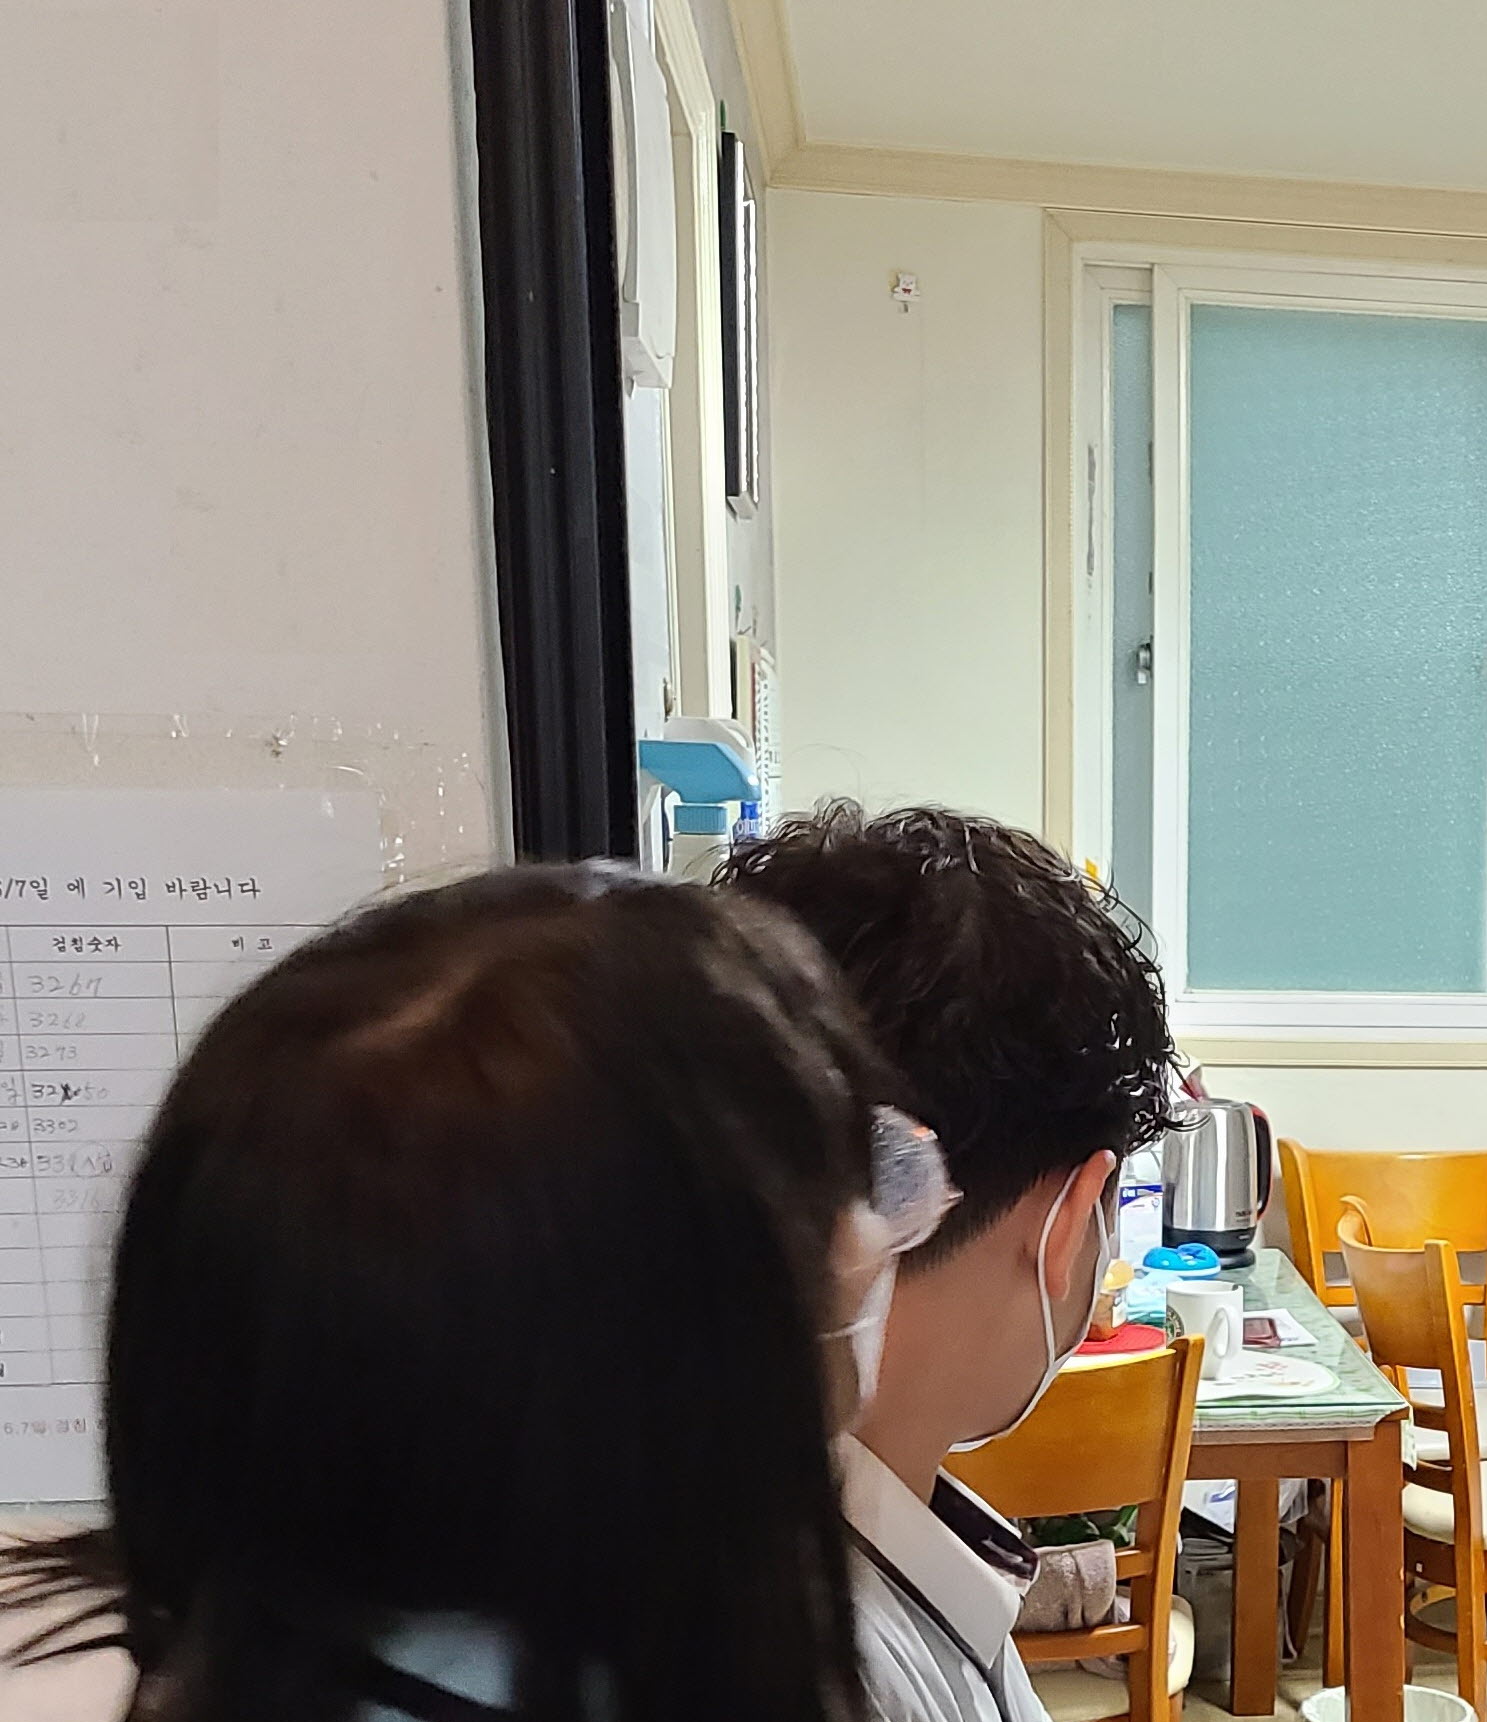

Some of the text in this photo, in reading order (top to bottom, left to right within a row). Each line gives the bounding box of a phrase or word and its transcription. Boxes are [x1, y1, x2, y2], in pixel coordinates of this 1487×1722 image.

[0, 876, 262, 900] /7일 에 기입 바람니다
[52, 935, 122, 952] 검침숫자
